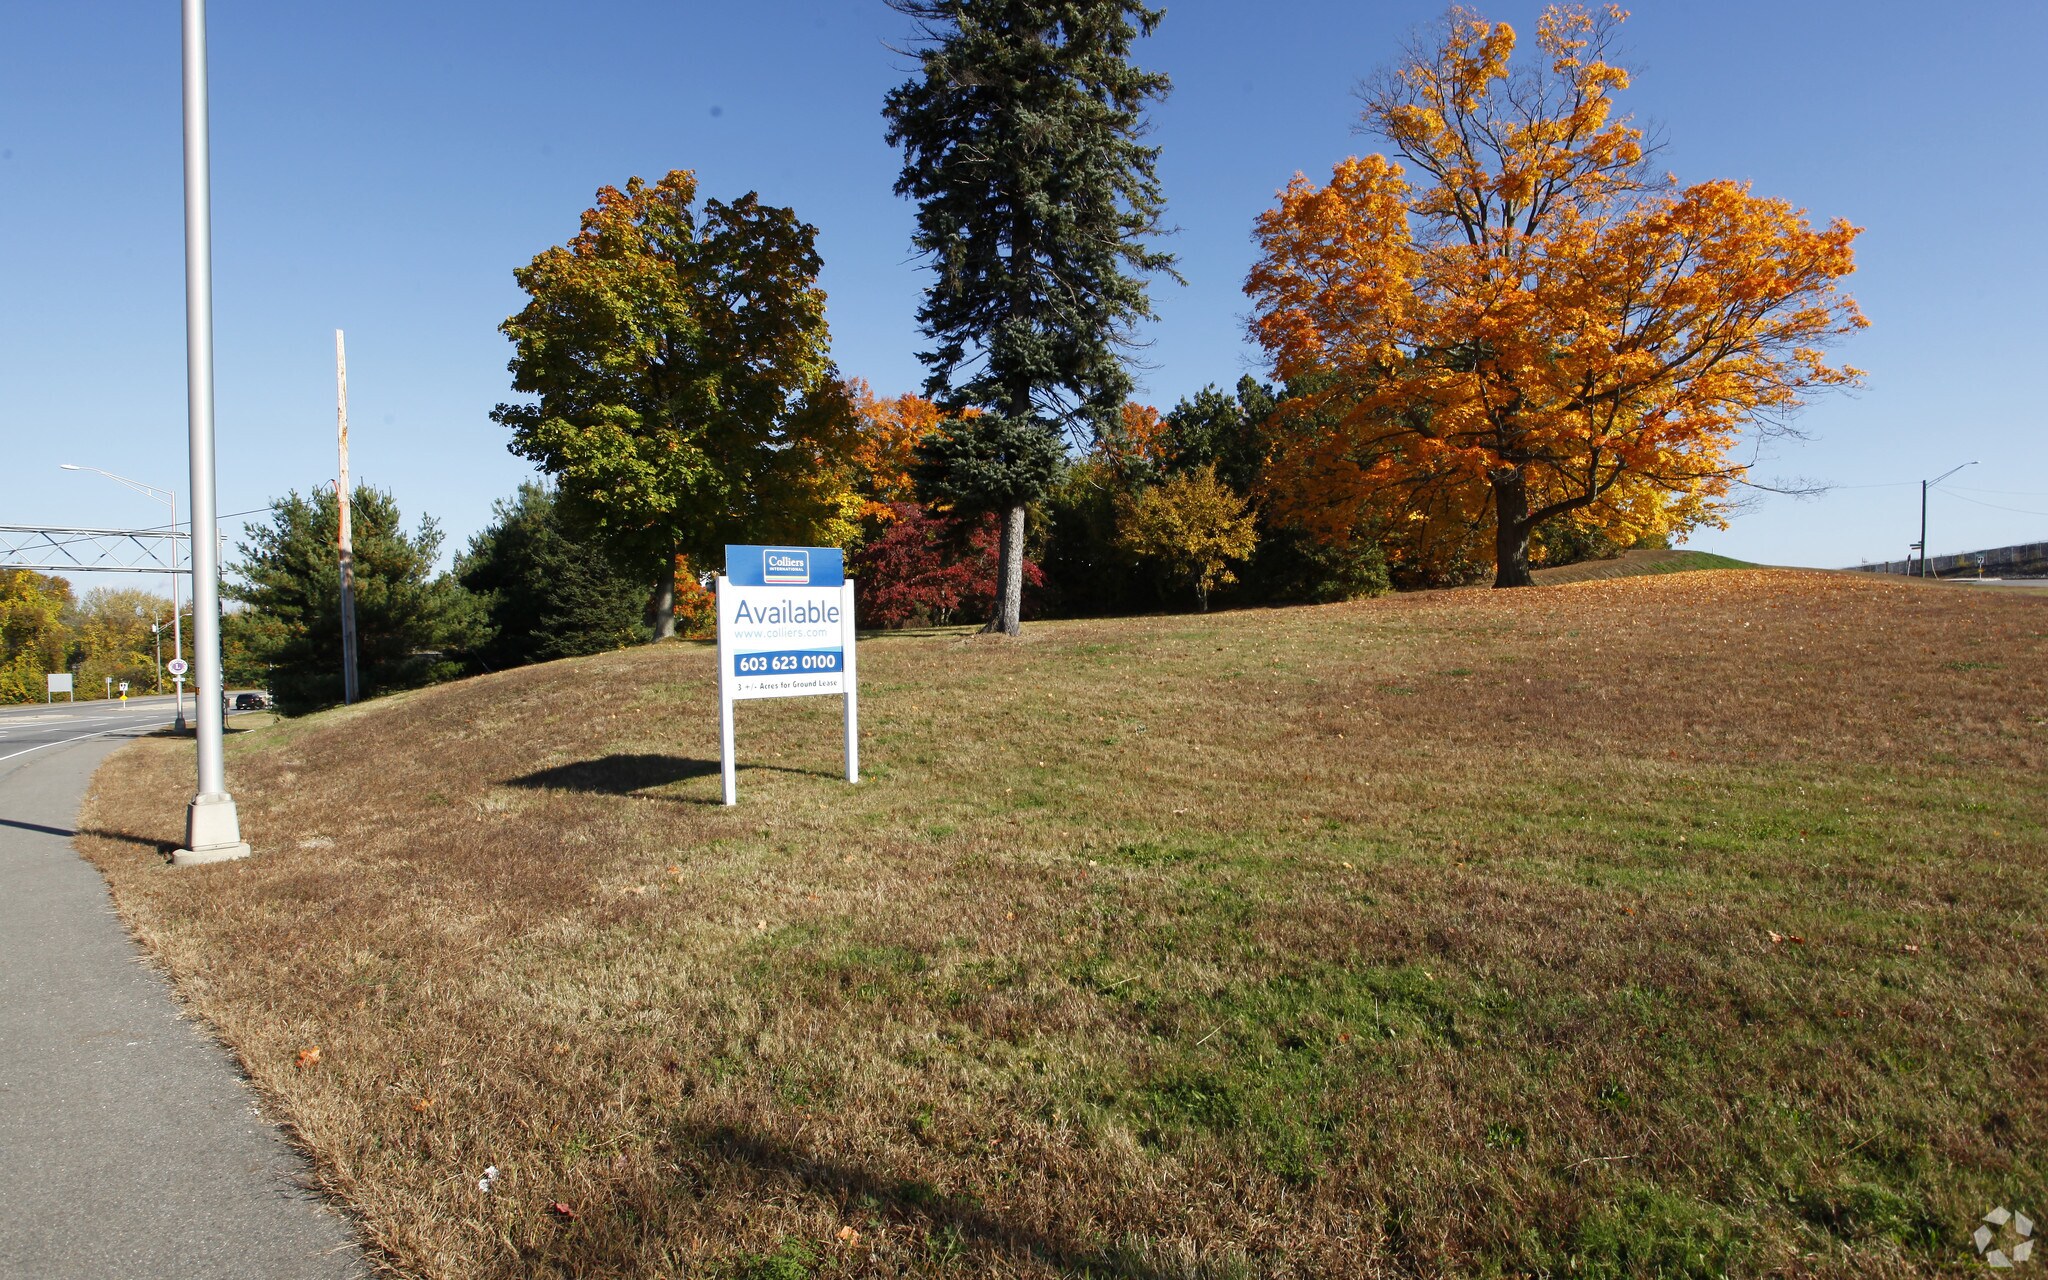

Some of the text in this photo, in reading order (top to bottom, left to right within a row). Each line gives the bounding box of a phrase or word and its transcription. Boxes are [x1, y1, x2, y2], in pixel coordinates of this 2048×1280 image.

[769, 556, 804, 567] Colliers
[734, 599, 839, 624] Available
[734, 628, 827, 638] www.colliers.com
[740, 655, 835, 671] 603 623 0100
